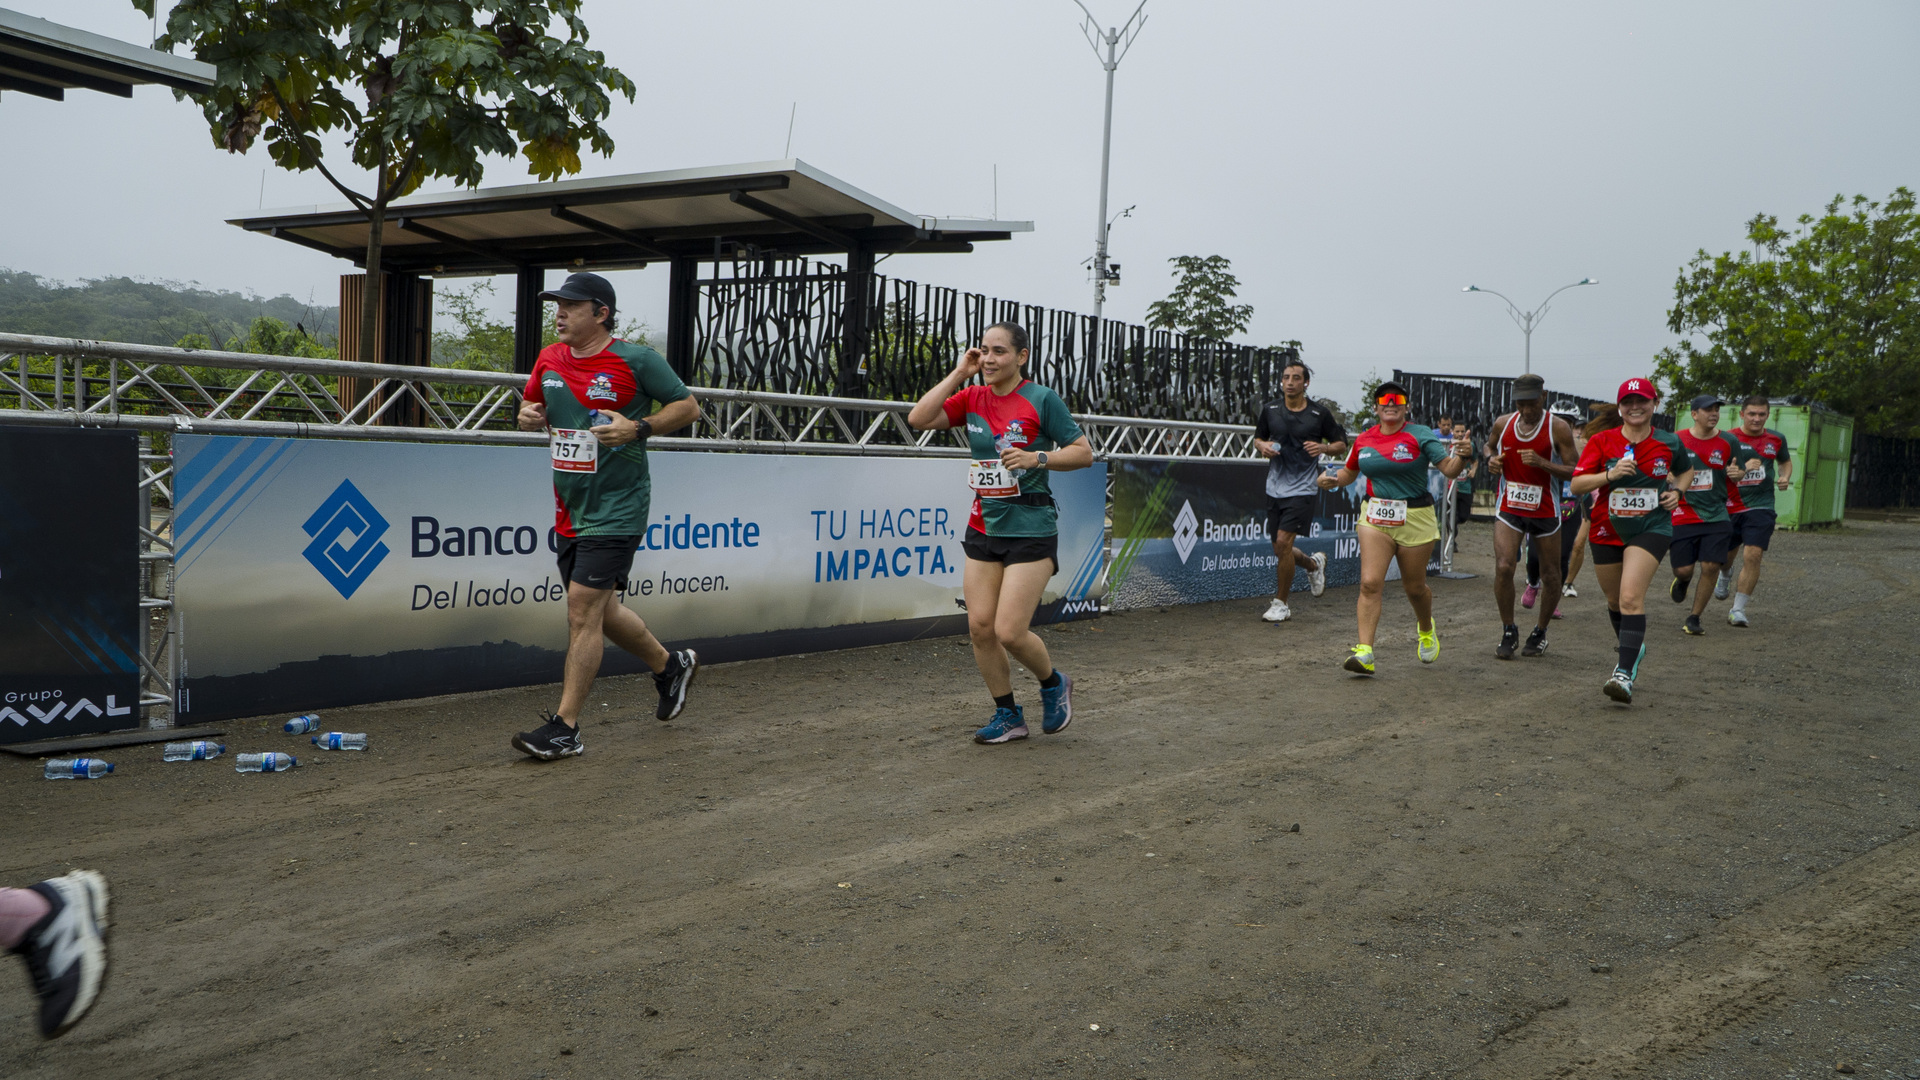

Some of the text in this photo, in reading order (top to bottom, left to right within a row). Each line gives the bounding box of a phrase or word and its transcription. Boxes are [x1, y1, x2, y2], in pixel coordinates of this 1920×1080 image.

[555, 442, 580, 458] 757
[978, 472, 1002, 486] 251
[1510, 490, 1535, 502] 1435
[1621, 497, 1645, 508] 343
[1376, 508, 1395, 519] 499
[811, 510, 847, 541] TU
[859, 508, 955, 539] HACER,
[1203, 518, 1243, 542] Banco
[1246, 517, 1261, 540] de
[1334, 514, 1349, 533] TU
[411, 515, 538, 558] Banco
[636, 514, 760, 551] cidente
[815, 545, 954, 583] IMPACTA.
[1202, 554, 1218, 572] Del
[1219, 553, 1238, 570] lado
[1239, 552, 1250, 567] de
[1252, 552, 1264, 567] los
[411, 581, 458, 611] Del
[467, 579, 526, 608] lado
[533, 576, 563, 602] de
[660, 570, 729, 595] hacen.
[1062, 600, 1099, 614] AVAL
[5, 689, 63, 703] Grupo
[0, 694, 131, 727] AVAL
